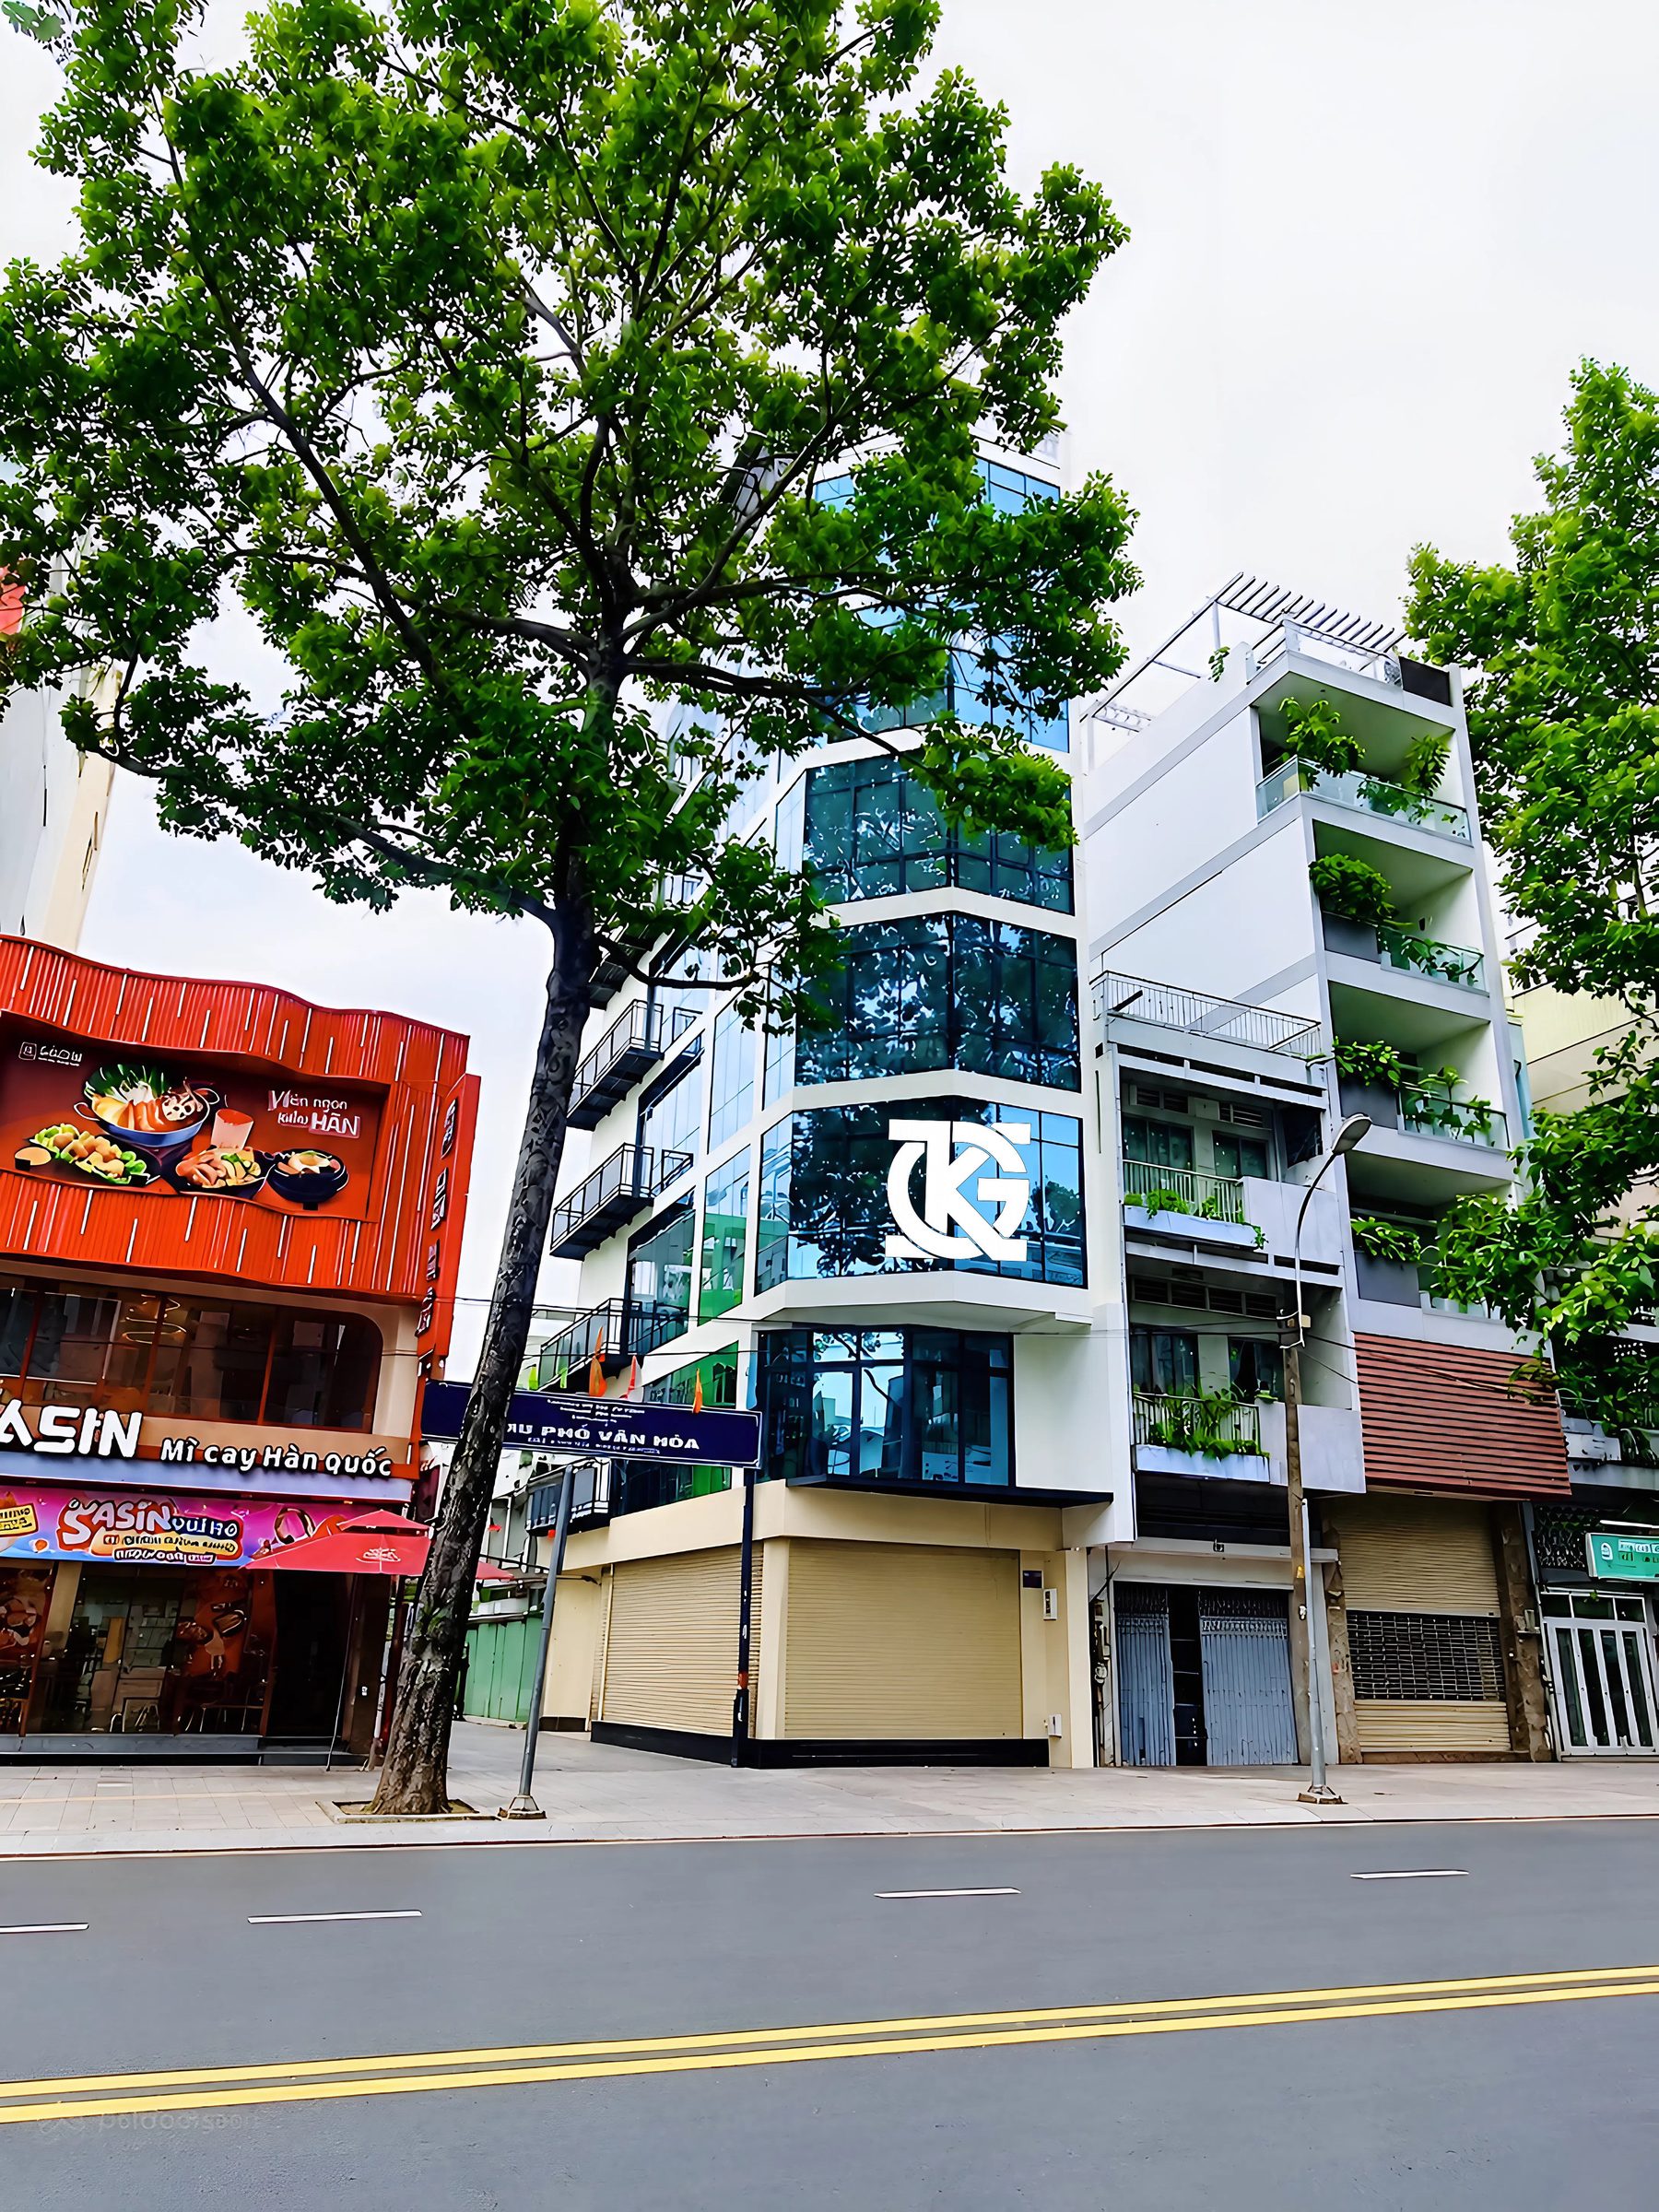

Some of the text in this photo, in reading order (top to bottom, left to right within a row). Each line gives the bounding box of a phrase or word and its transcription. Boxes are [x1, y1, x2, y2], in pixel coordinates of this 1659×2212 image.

[160, 1438, 198, 1463] Mì
[204, 1445, 257, 1472] cay
[263, 1443, 318, 1471] Hàn
[62, 1499, 172, 1546] SASIN
